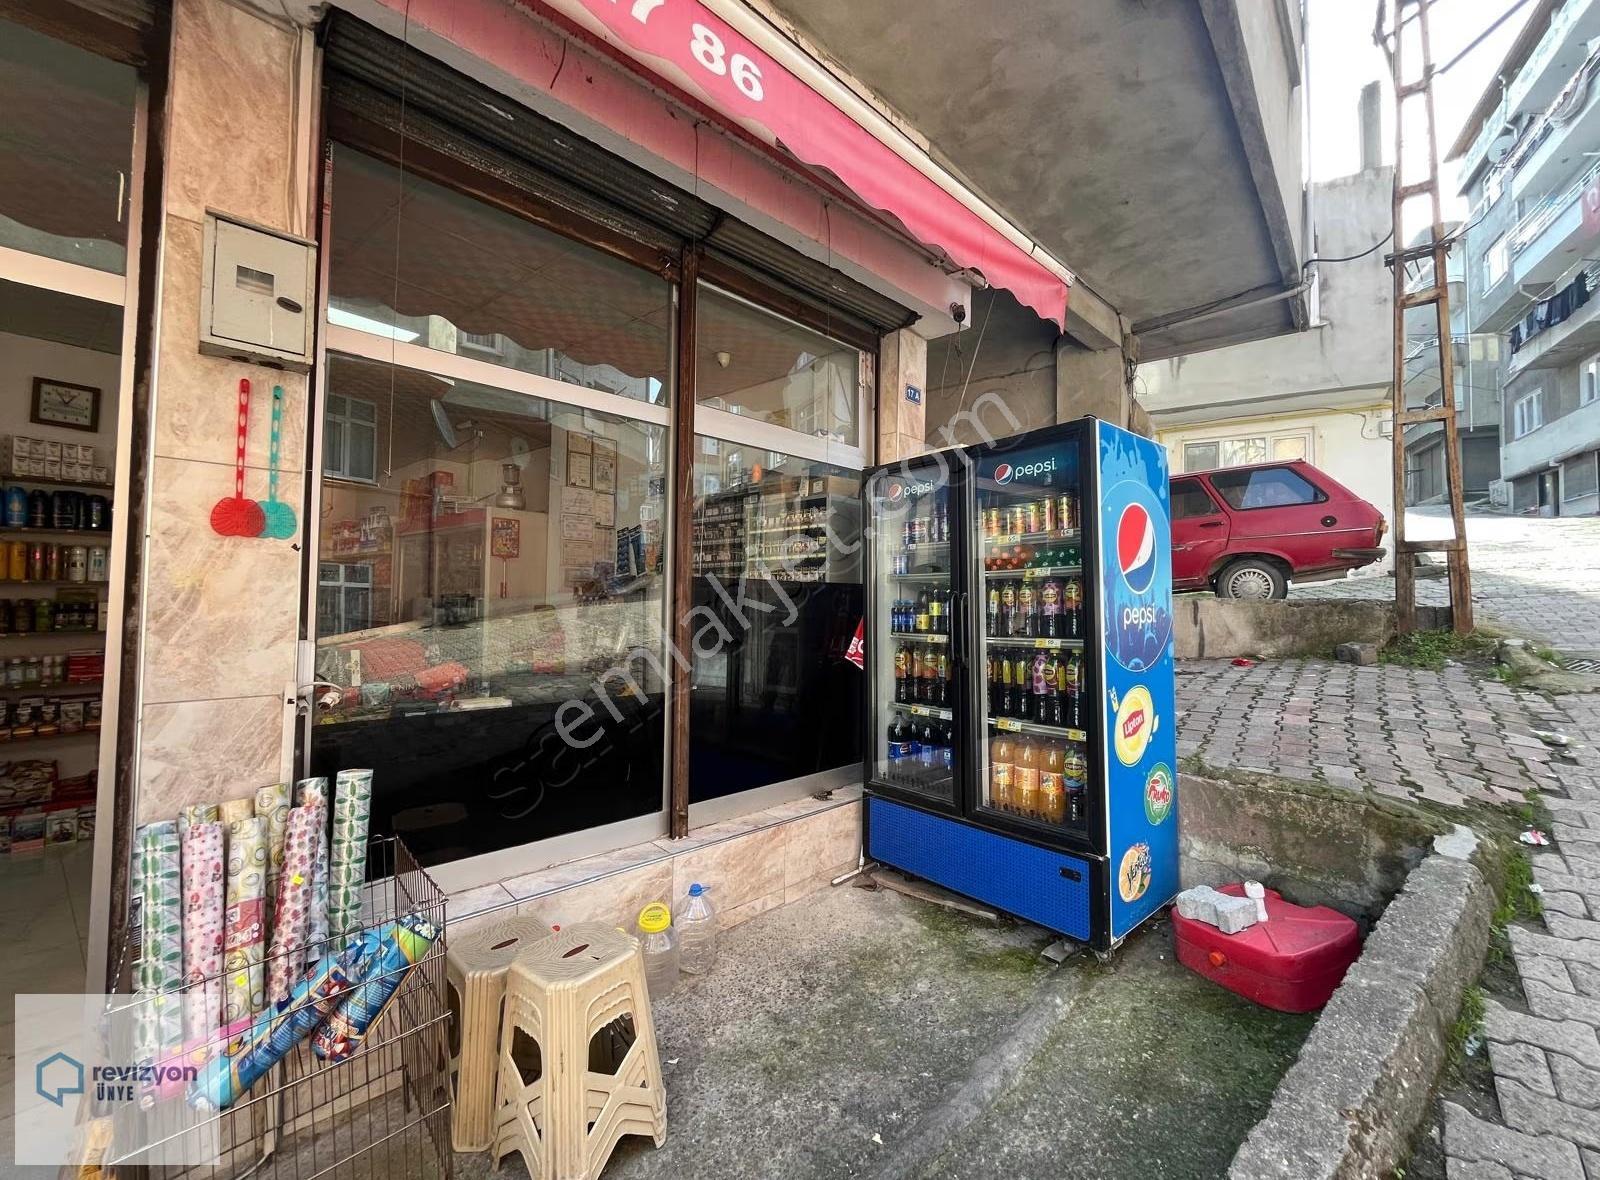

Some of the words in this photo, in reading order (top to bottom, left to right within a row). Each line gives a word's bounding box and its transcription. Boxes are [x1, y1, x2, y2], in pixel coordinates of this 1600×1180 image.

[690, 23, 763, 102] 86
[1015, 457, 1056, 480] pepsi
[903, 480, 934, 498] pepsi
[1123, 602, 1156, 631] pepsi
[1124, 713, 1144, 736] Lipton
